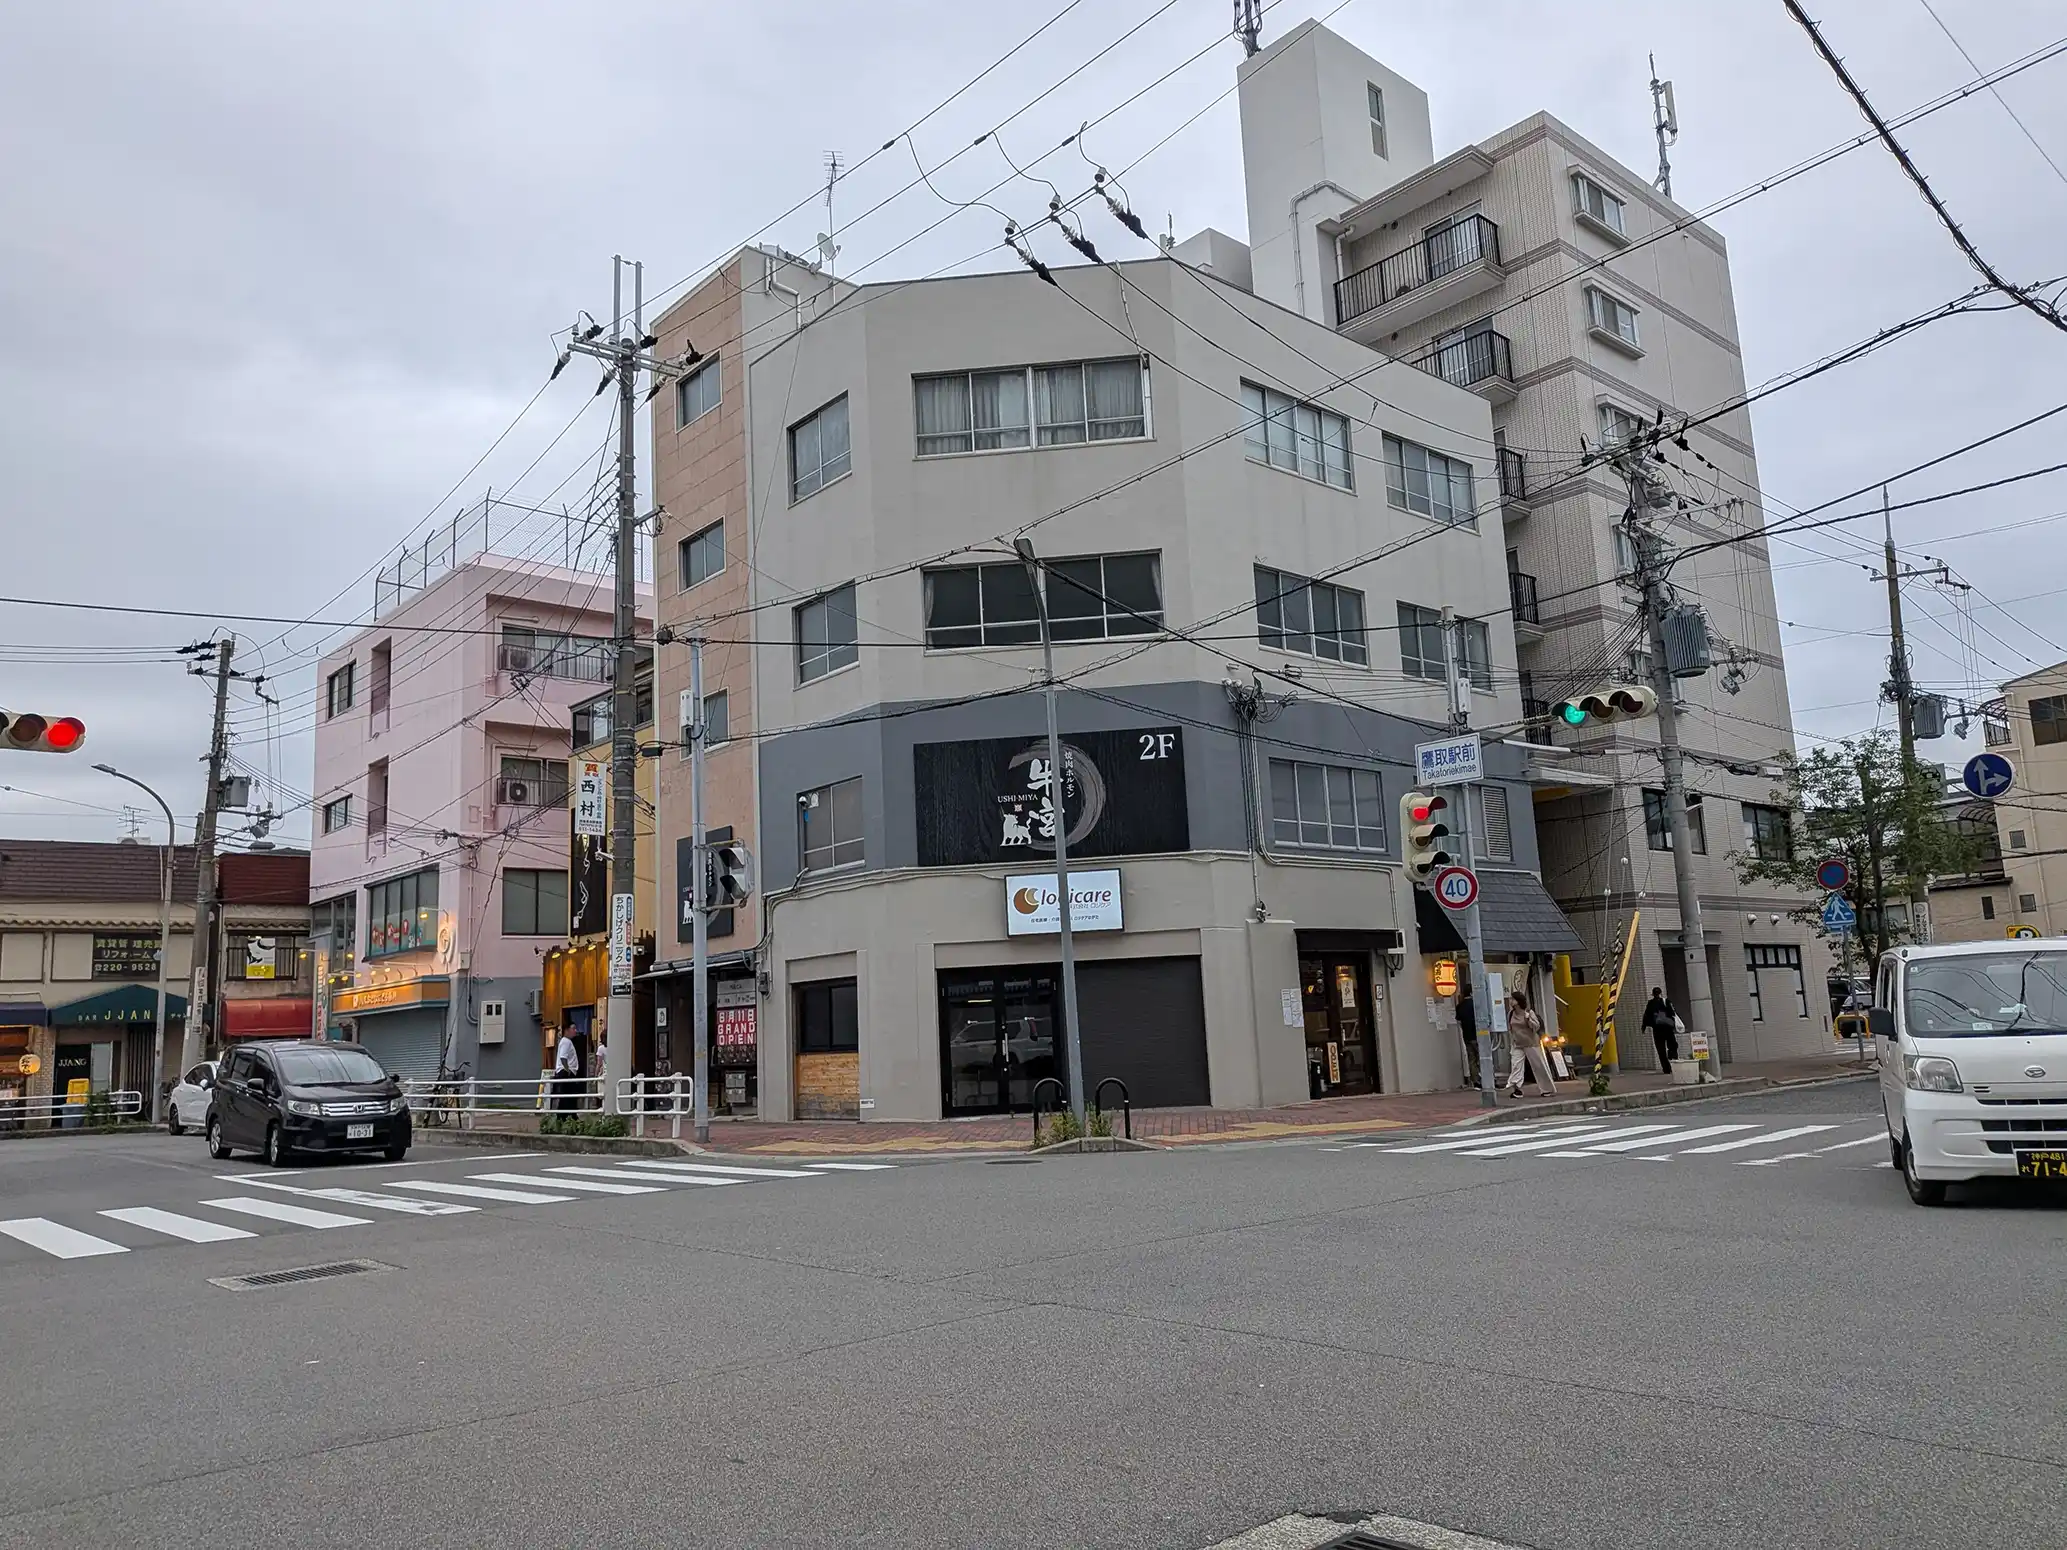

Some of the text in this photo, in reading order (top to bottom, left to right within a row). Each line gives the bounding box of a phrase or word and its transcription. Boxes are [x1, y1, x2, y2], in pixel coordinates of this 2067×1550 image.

[1138, 734, 1175, 760] 2F
[1421, 743, 1476, 769] 鷹取駅前
[1064, 751, 1075, 798] 焼肉ホルモン
[1422, 763, 1477, 780] Takatoriekimae
[580, 780, 596, 817] 西村
[1041, 888, 1112, 907] loicare
[1444, 879, 1468, 898] 40
[615, 896, 624, 963] ちかしげクリニック
[103, 950, 150, 959] リフォーム
[717, 1022, 756, 1034] GRAND
[719, 1034, 754, 1045] OPEN
[58, 1058, 87, 1067] JJANG
[1330, 1045, 1339, 1081] OPEN
